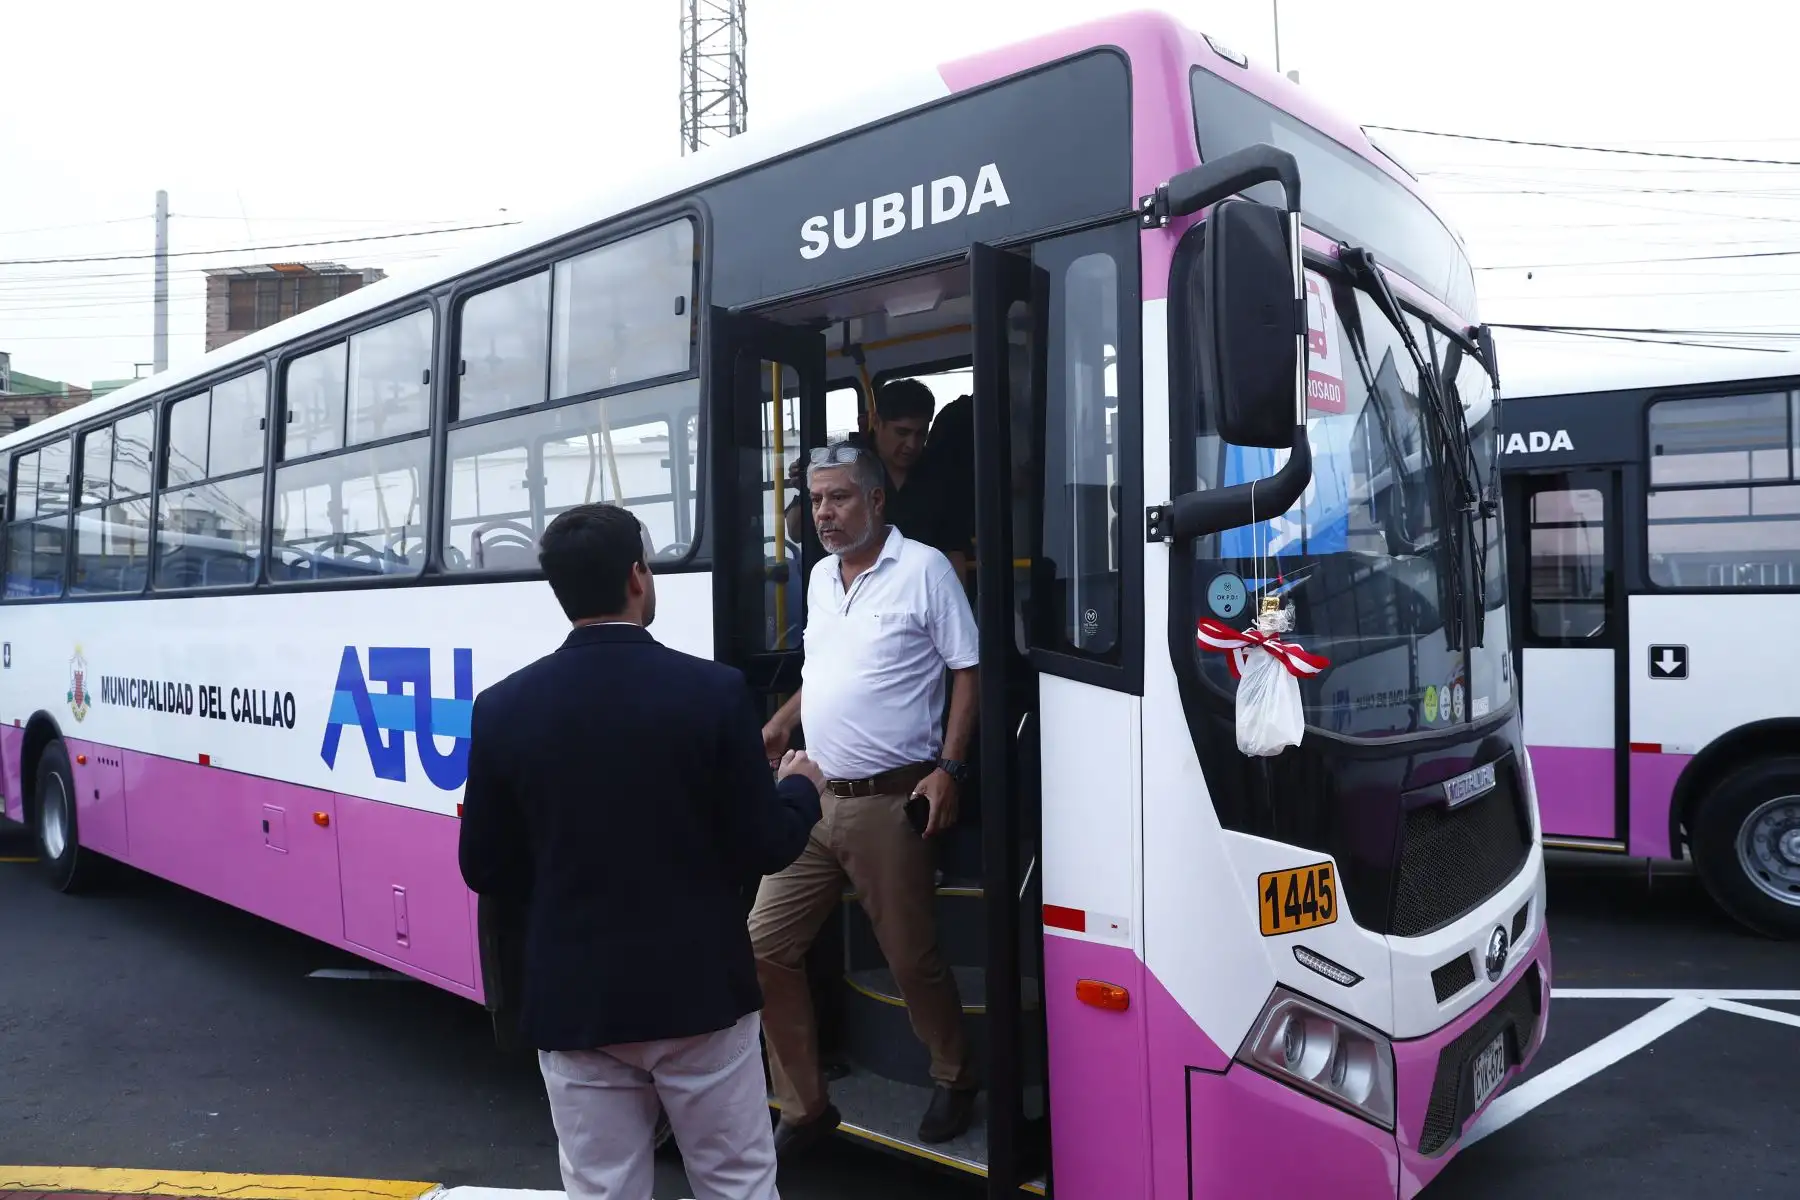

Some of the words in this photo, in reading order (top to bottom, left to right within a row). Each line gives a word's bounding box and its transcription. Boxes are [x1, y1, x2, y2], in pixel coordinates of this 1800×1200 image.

[800, 162, 1010, 260] SUBIDA
[101, 675, 194, 716] MUNICIPALIDAD
[199, 684, 227, 720] DEL
[231, 687, 296, 729] CALLAO
[320, 645, 472, 791] ATU
[1264, 867, 1333, 929] 1445
